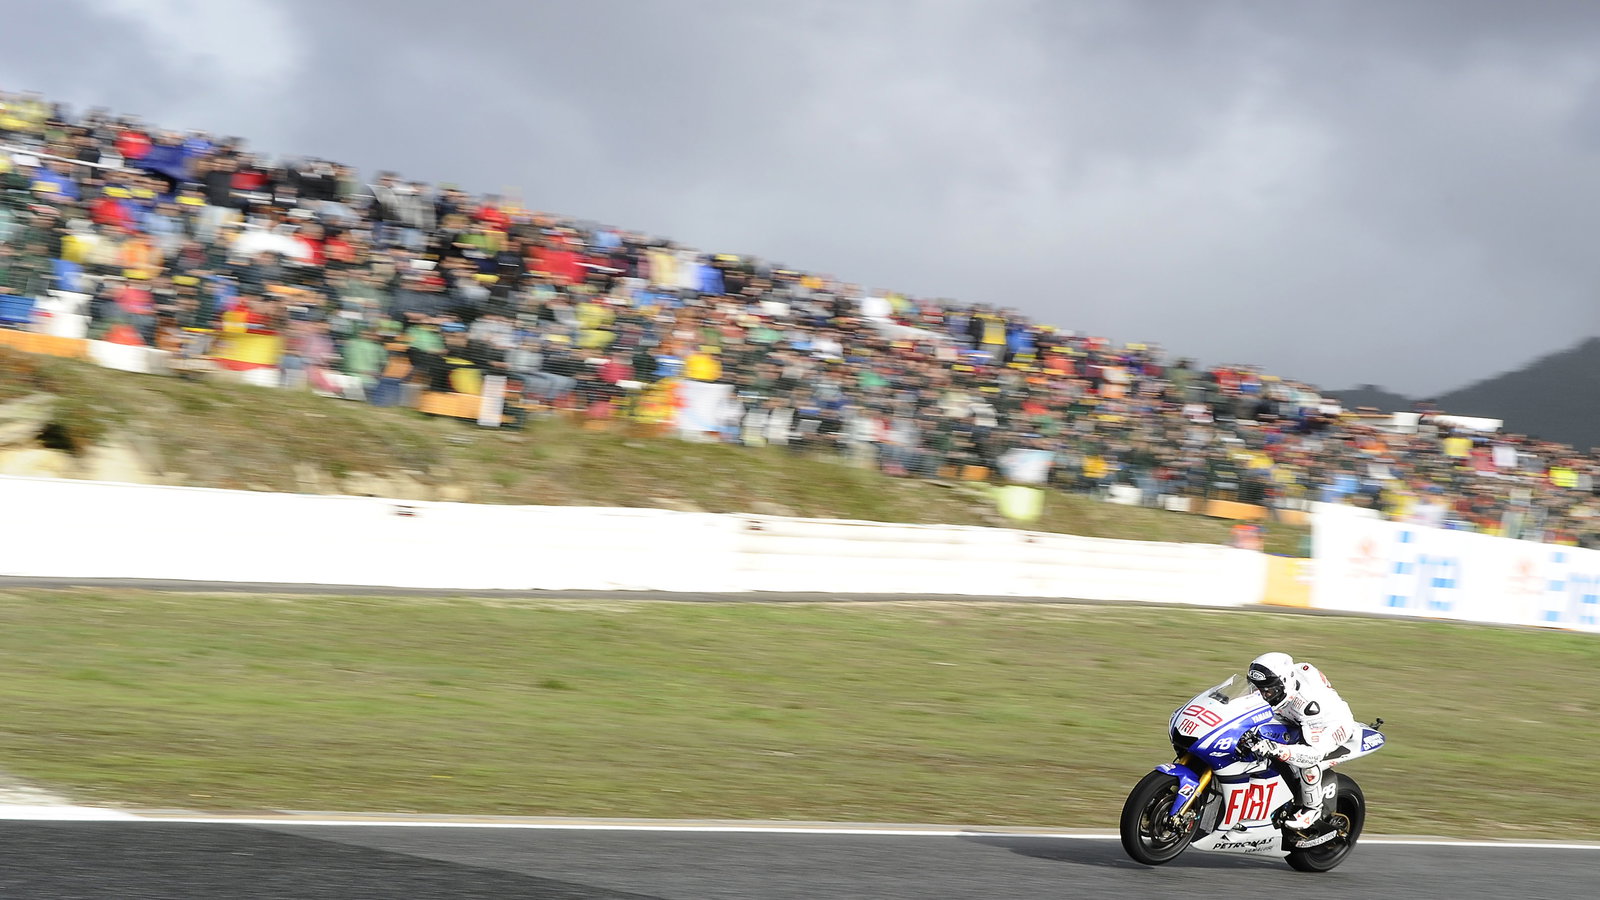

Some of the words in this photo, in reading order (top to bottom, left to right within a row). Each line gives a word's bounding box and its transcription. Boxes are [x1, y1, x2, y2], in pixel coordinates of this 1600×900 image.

[1183, 705, 1223, 728] 99
[1178, 718, 1200, 736] FIAT
[1225, 782, 1278, 825] FIAT
[1213, 836, 1275, 850] PETRONAS
